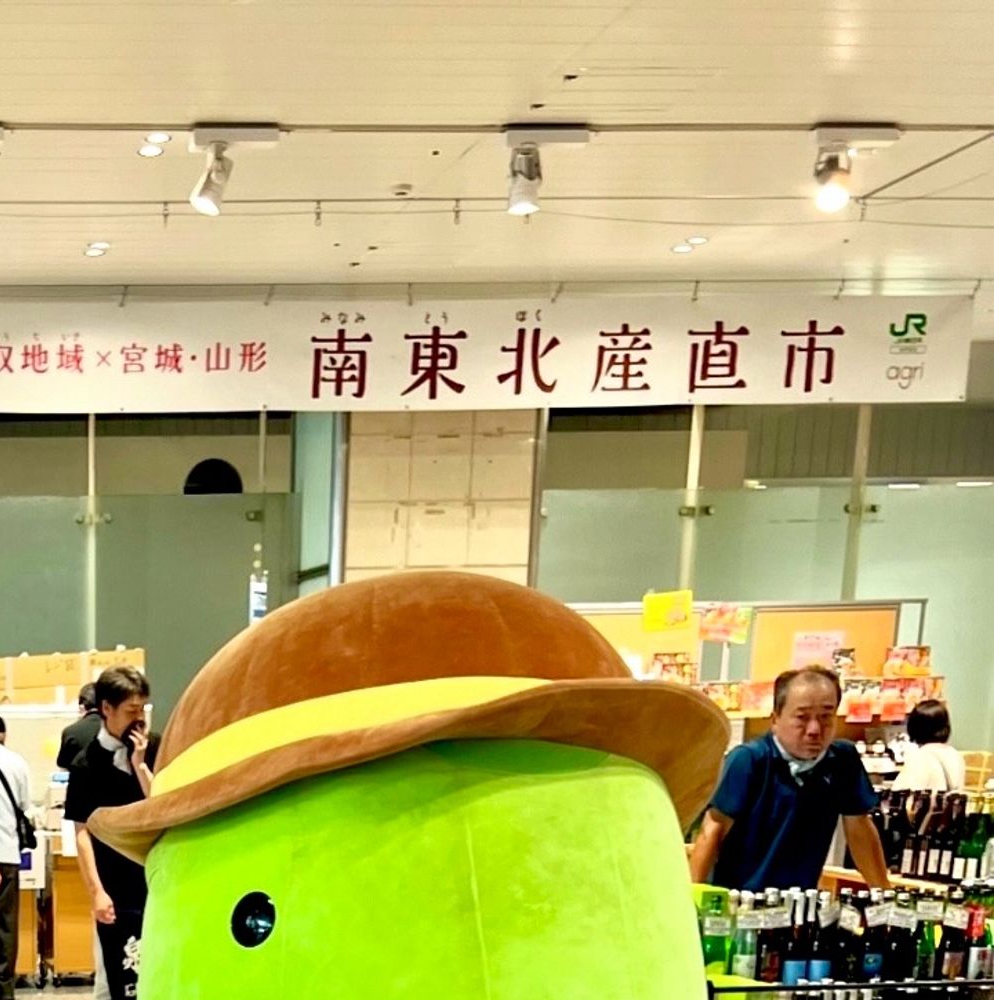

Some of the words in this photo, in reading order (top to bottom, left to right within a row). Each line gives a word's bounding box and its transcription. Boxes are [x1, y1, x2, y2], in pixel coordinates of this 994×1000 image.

[889, 313, 927, 337] JR
[310, 320, 846, 400] 南東北産直市
[886, 361, 925, 390] agri
